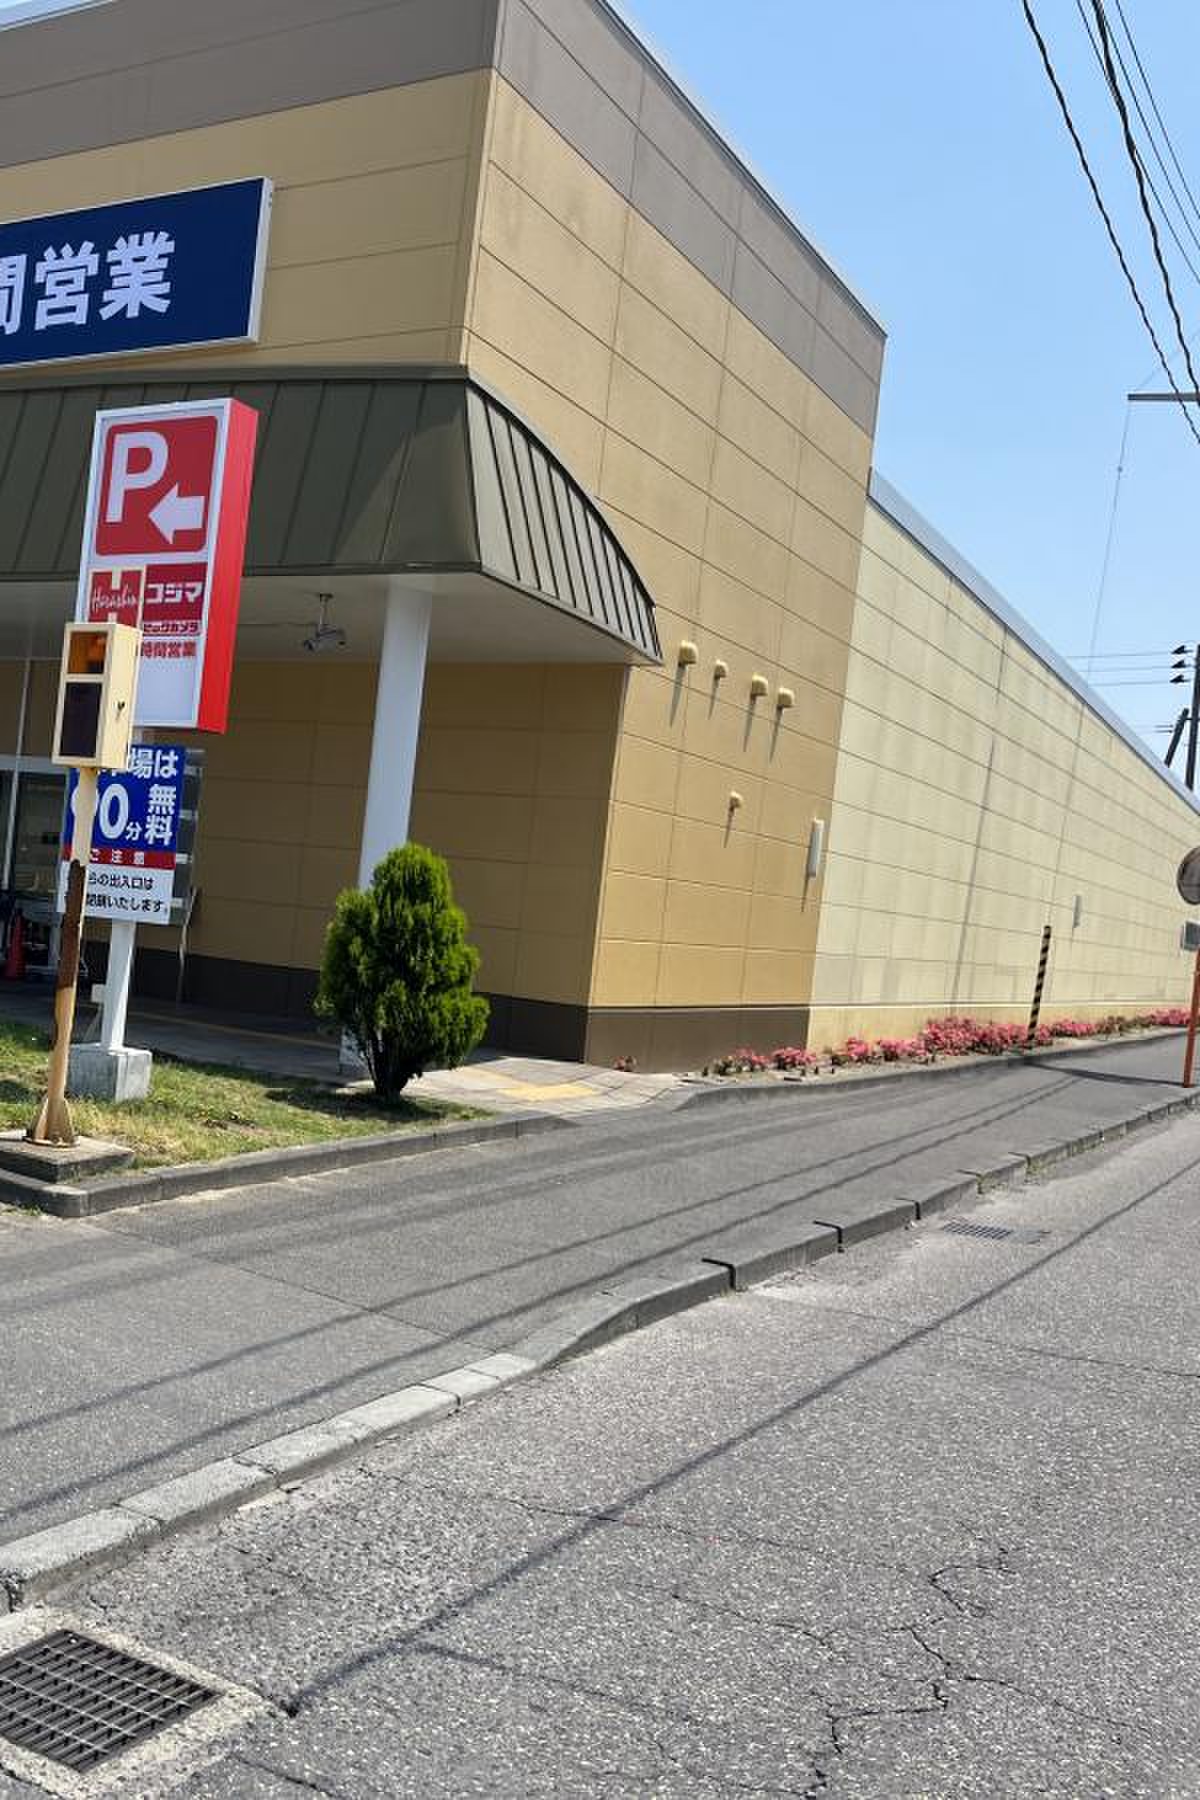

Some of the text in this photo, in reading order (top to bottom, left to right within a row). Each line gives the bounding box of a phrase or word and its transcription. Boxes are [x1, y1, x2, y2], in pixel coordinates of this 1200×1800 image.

[105, 431, 169, 523] P
[146, 582, 203, 604] コジマ
[141, 640, 196, 658] 時間営業
[145, 784, 176, 846] 無料
[88, 871, 155, 890] らの出入口は
